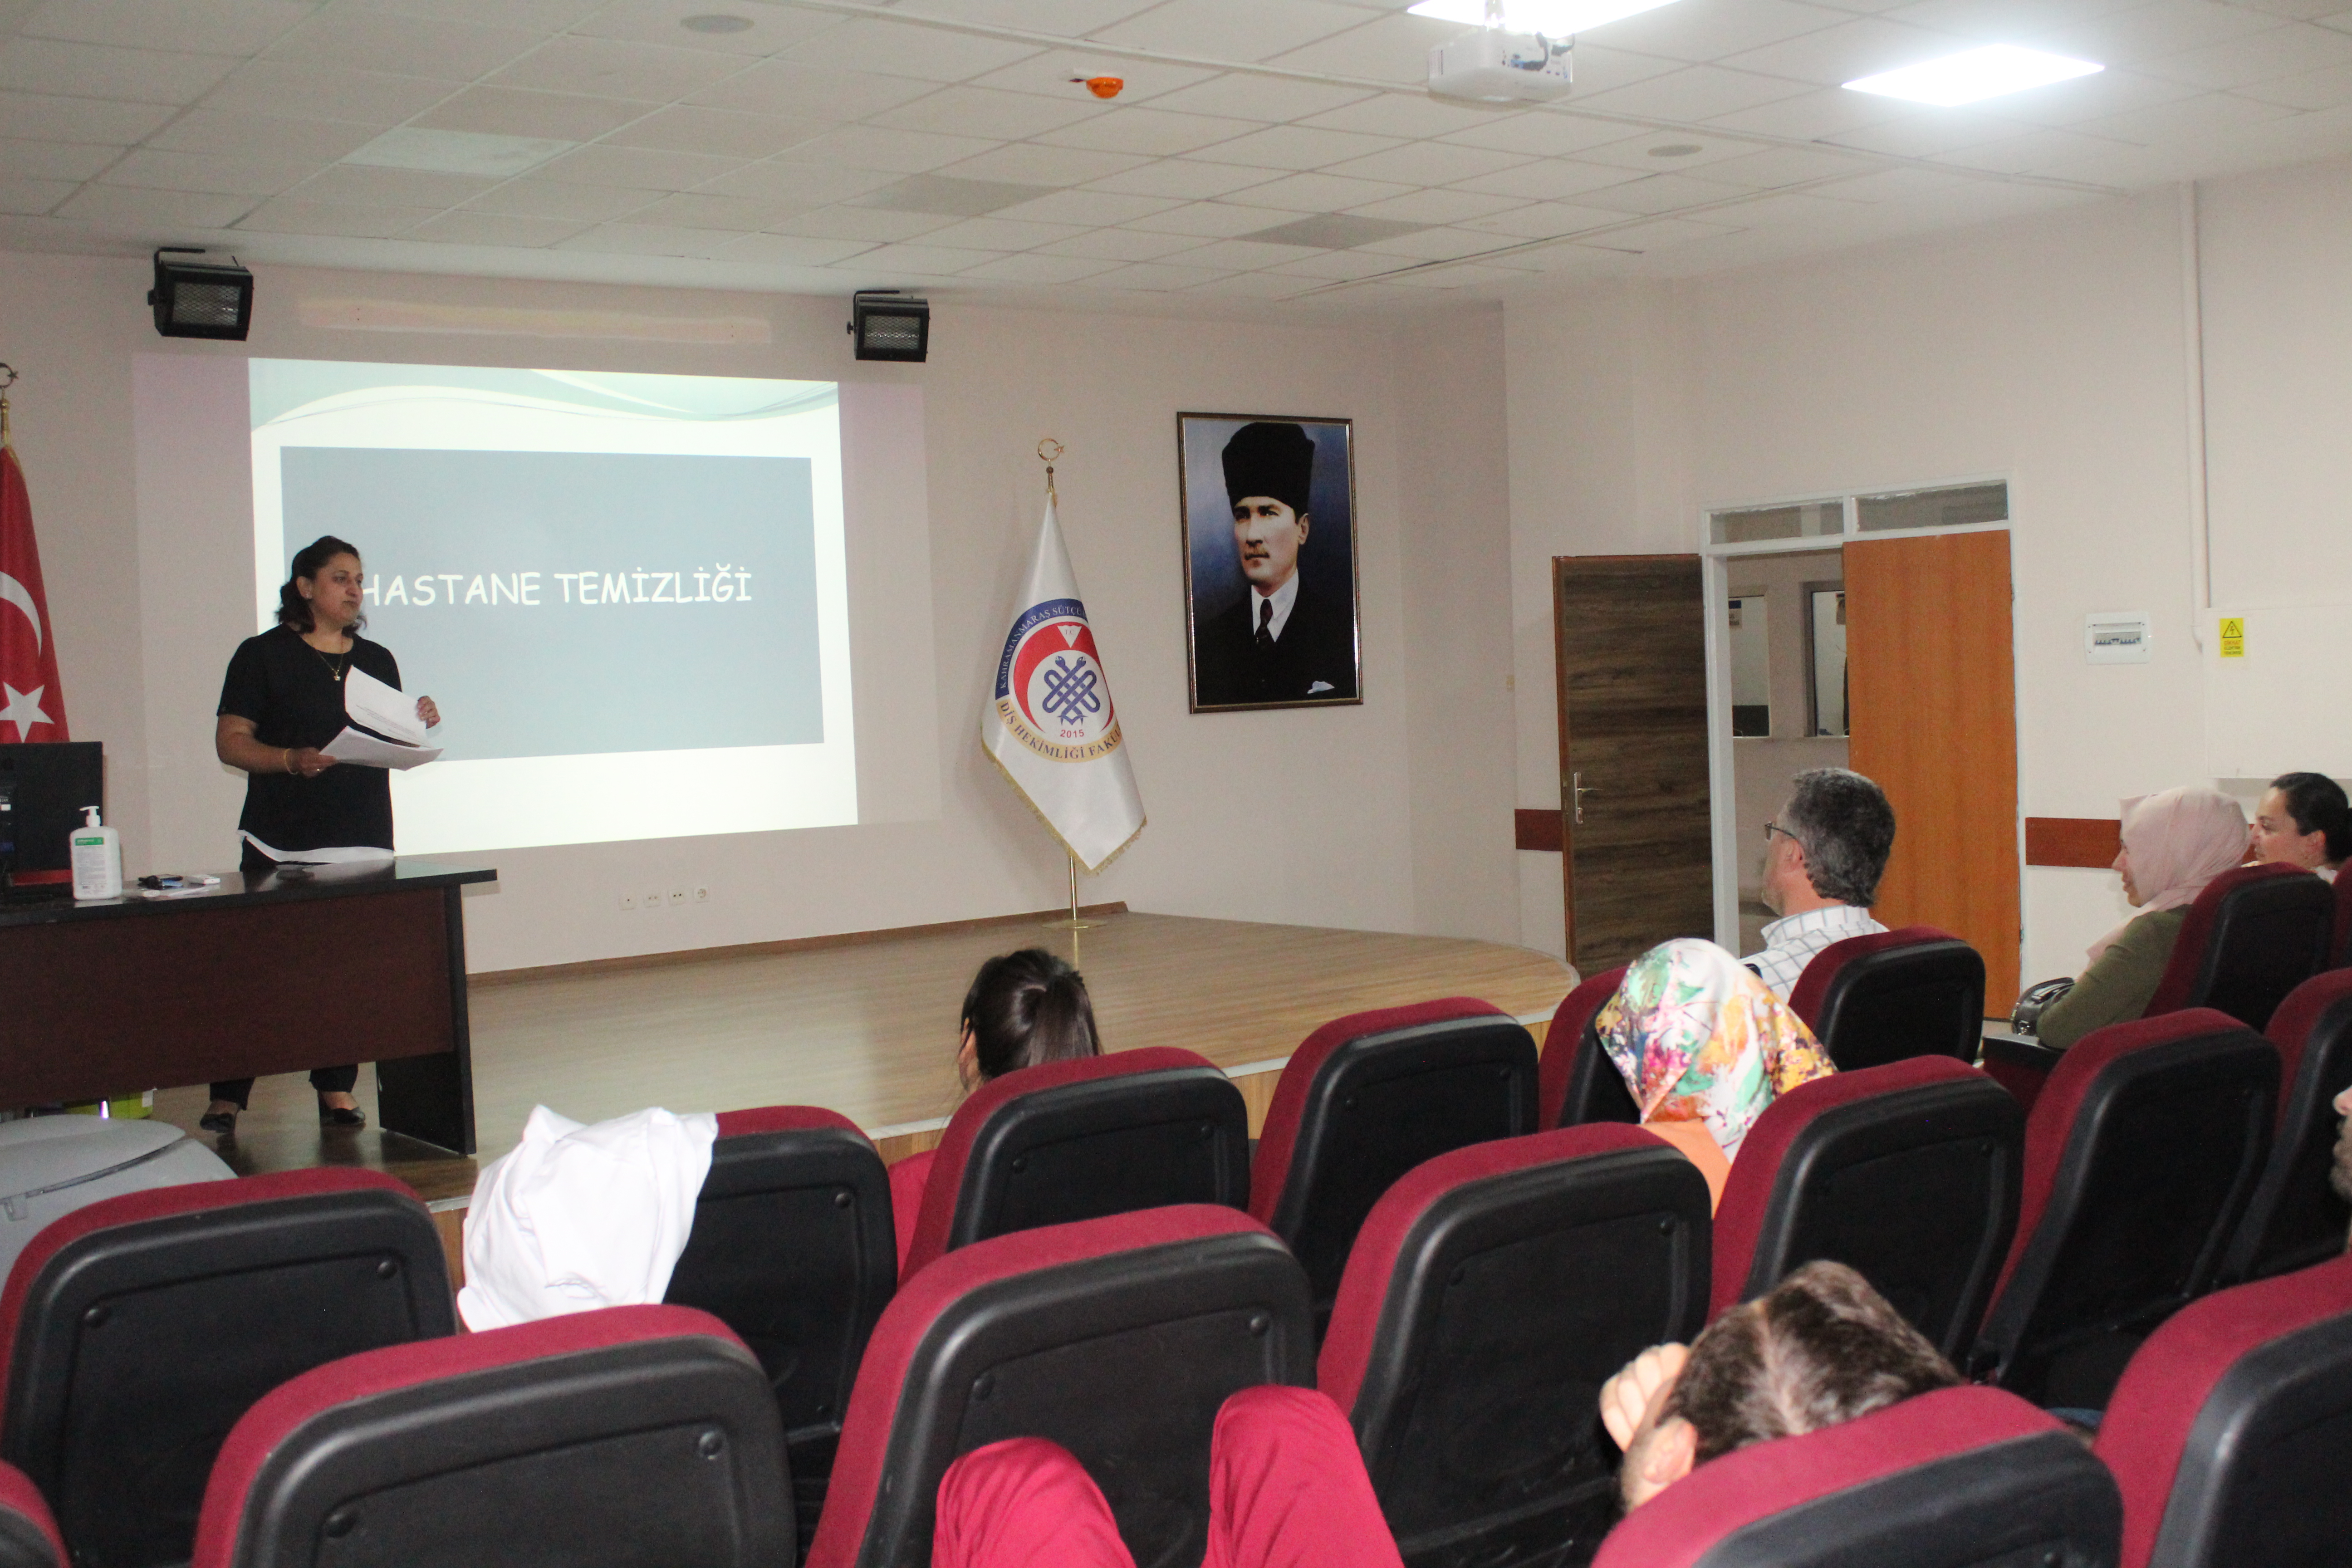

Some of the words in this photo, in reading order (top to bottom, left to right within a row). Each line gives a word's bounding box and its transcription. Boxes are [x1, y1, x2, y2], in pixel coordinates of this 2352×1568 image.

[363, 572, 541, 606] HASTANE
[554, 562, 752, 604] TEMİZLİĞİ
[1000, 609, 1050, 689] KAHRAMANMARAŞ
[1000, 701, 1017, 725] DİŞ
[1014, 725, 1085, 759] HEKİMLİĞİ
[1060, 729, 1085, 738] 2015
